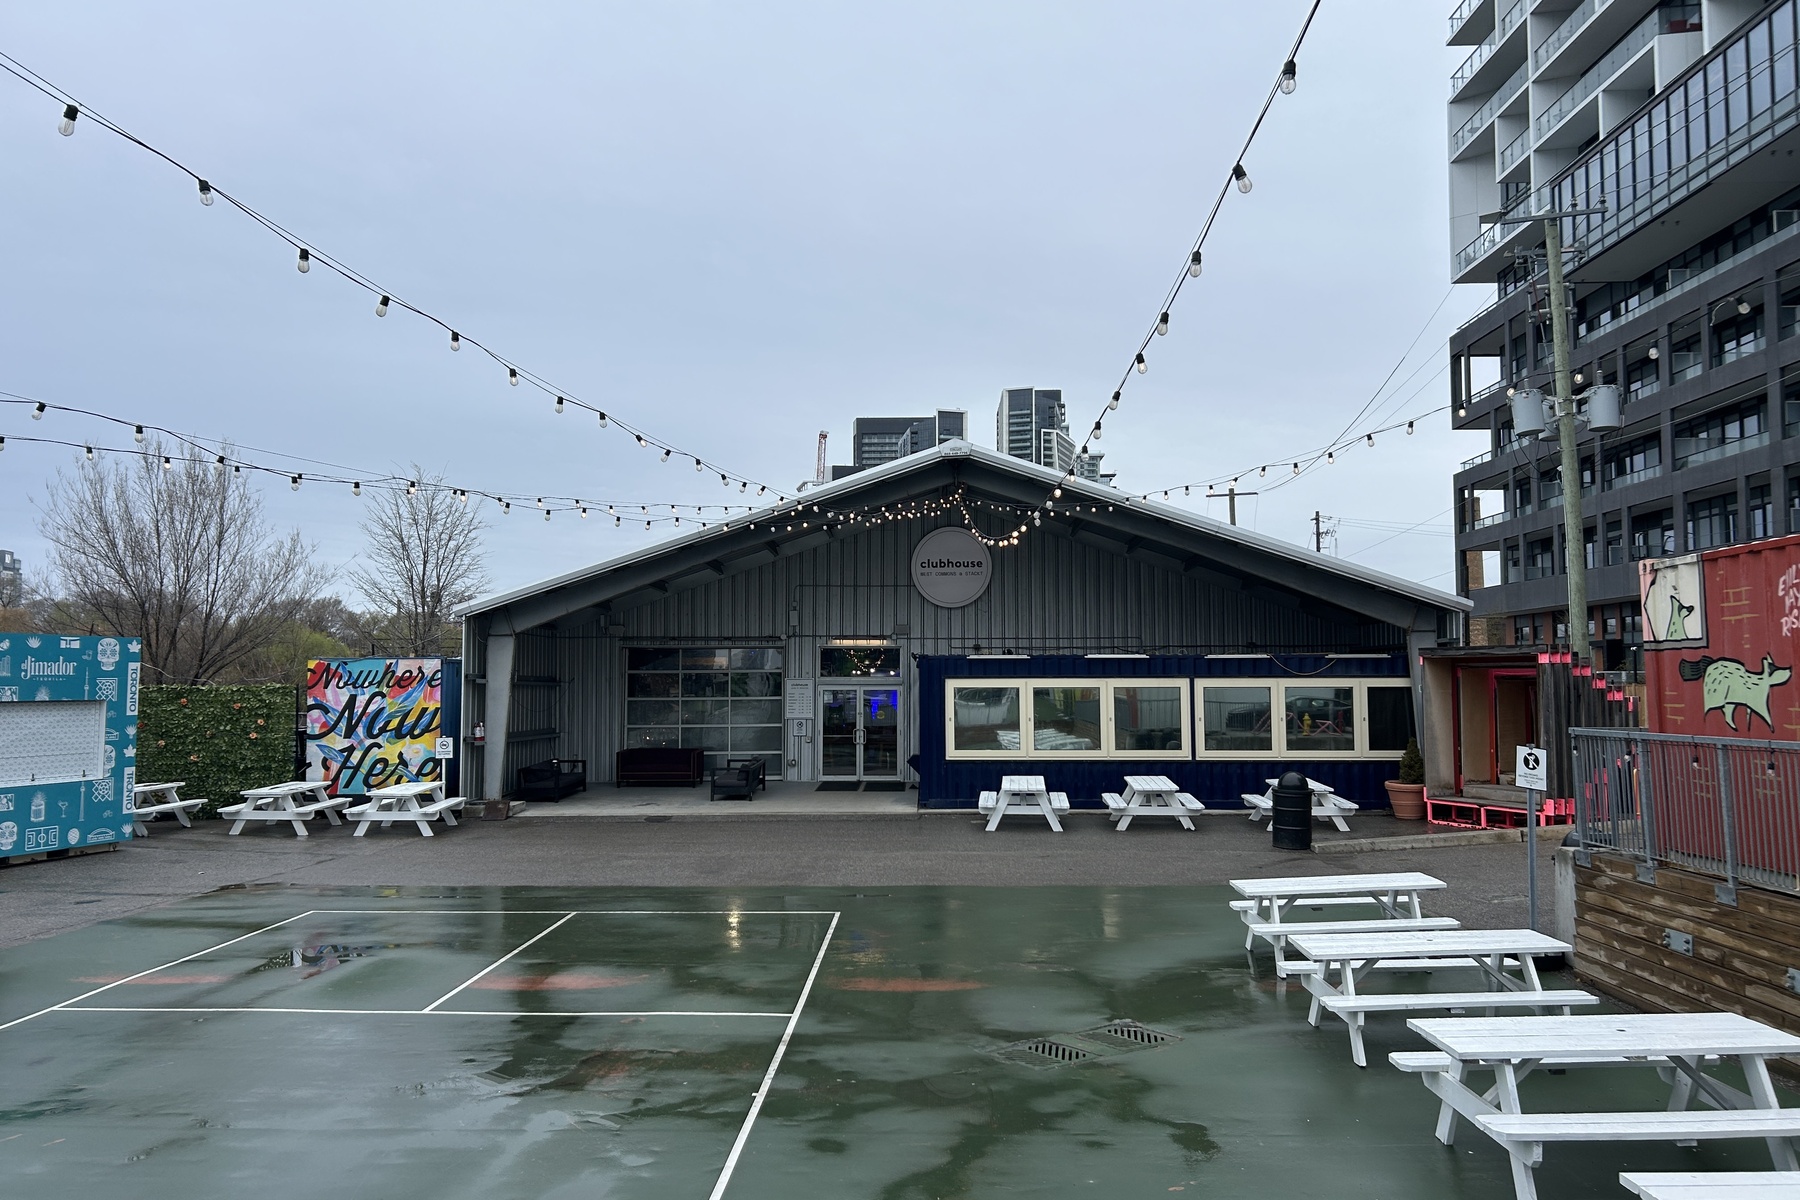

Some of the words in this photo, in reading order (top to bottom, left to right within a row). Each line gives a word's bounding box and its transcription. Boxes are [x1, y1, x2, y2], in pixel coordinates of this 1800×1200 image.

[920, 559, 983, 568] clubhouse
[129, 666, 138, 713] TORONTO
[307, 661, 441, 690] Nowhere
[306, 691, 441, 740] Now
[321, 742, 441, 790] Here
